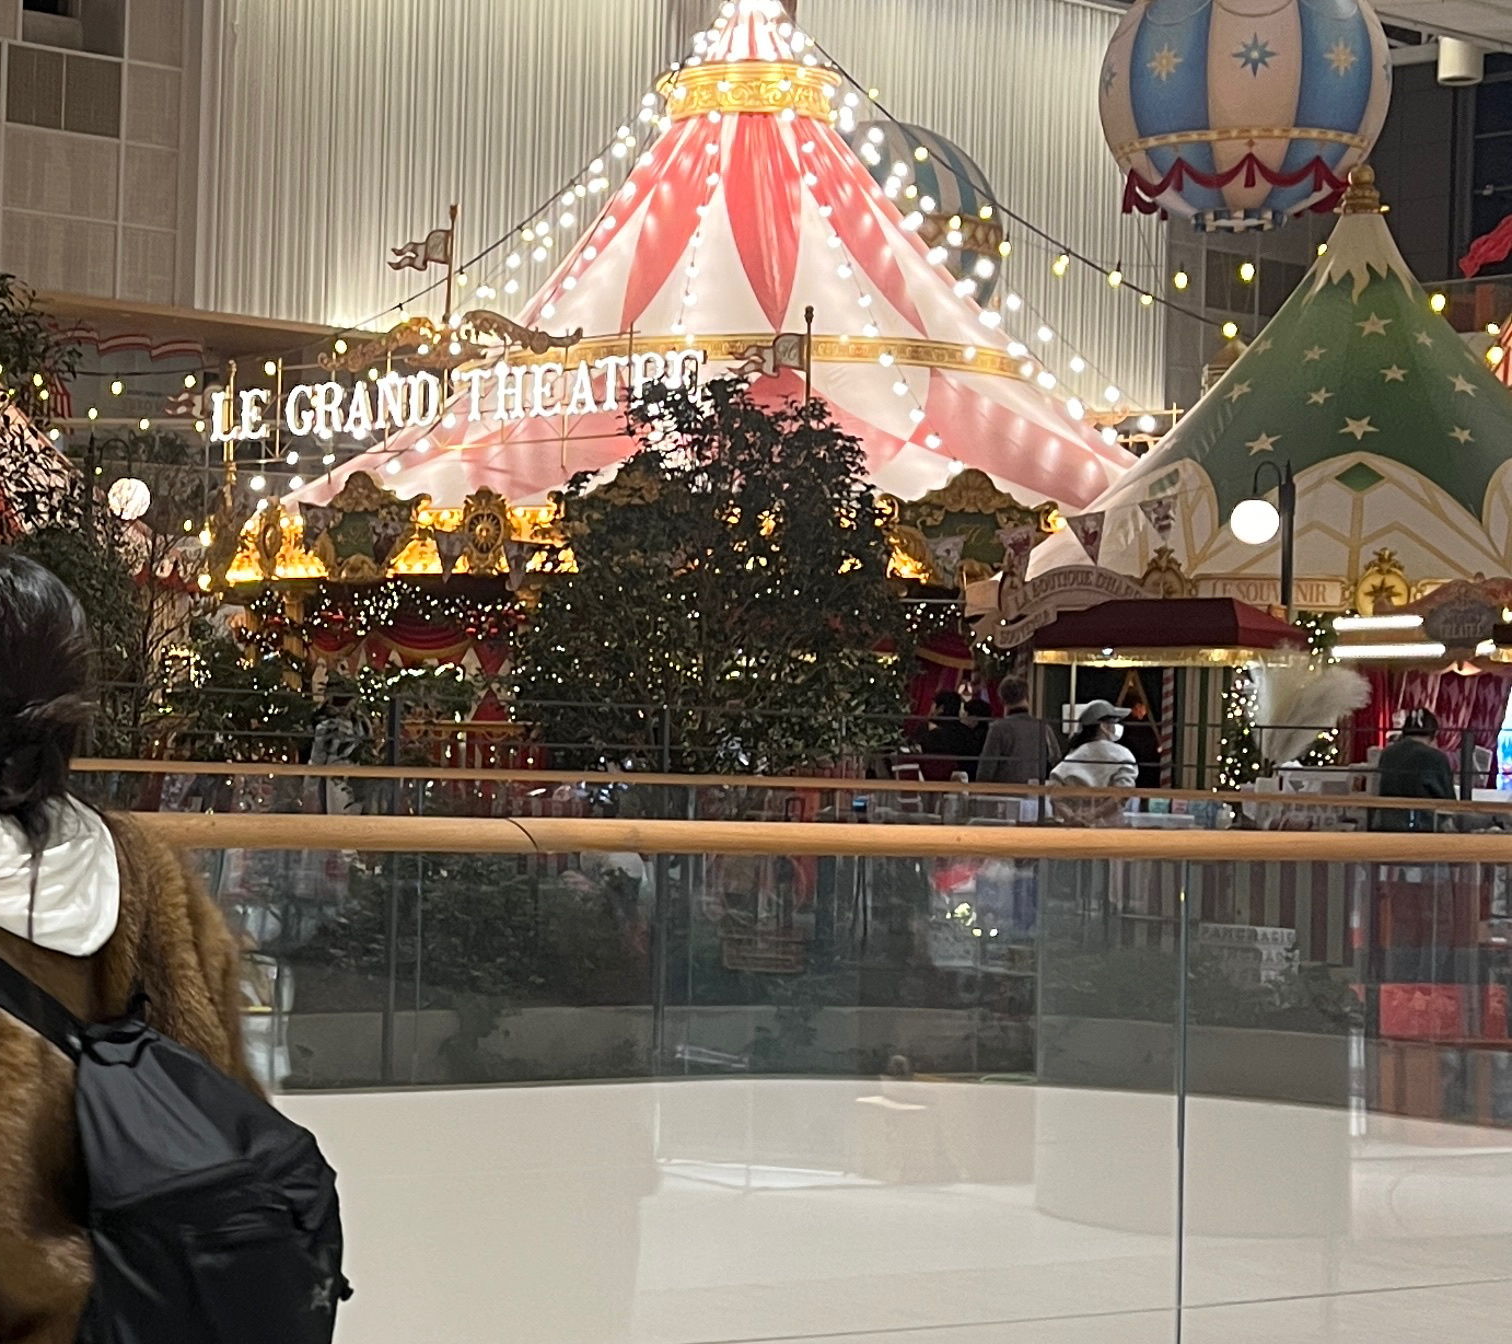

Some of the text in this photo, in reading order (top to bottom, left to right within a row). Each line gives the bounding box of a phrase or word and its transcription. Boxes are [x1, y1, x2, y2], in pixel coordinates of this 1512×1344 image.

[209, 386, 269, 443] LE
[285, 369, 442, 437] GRAND
[1032, 569, 1094, 598] BOUTIQUE
[1236, 581, 1327, 604] SOUVNIR
